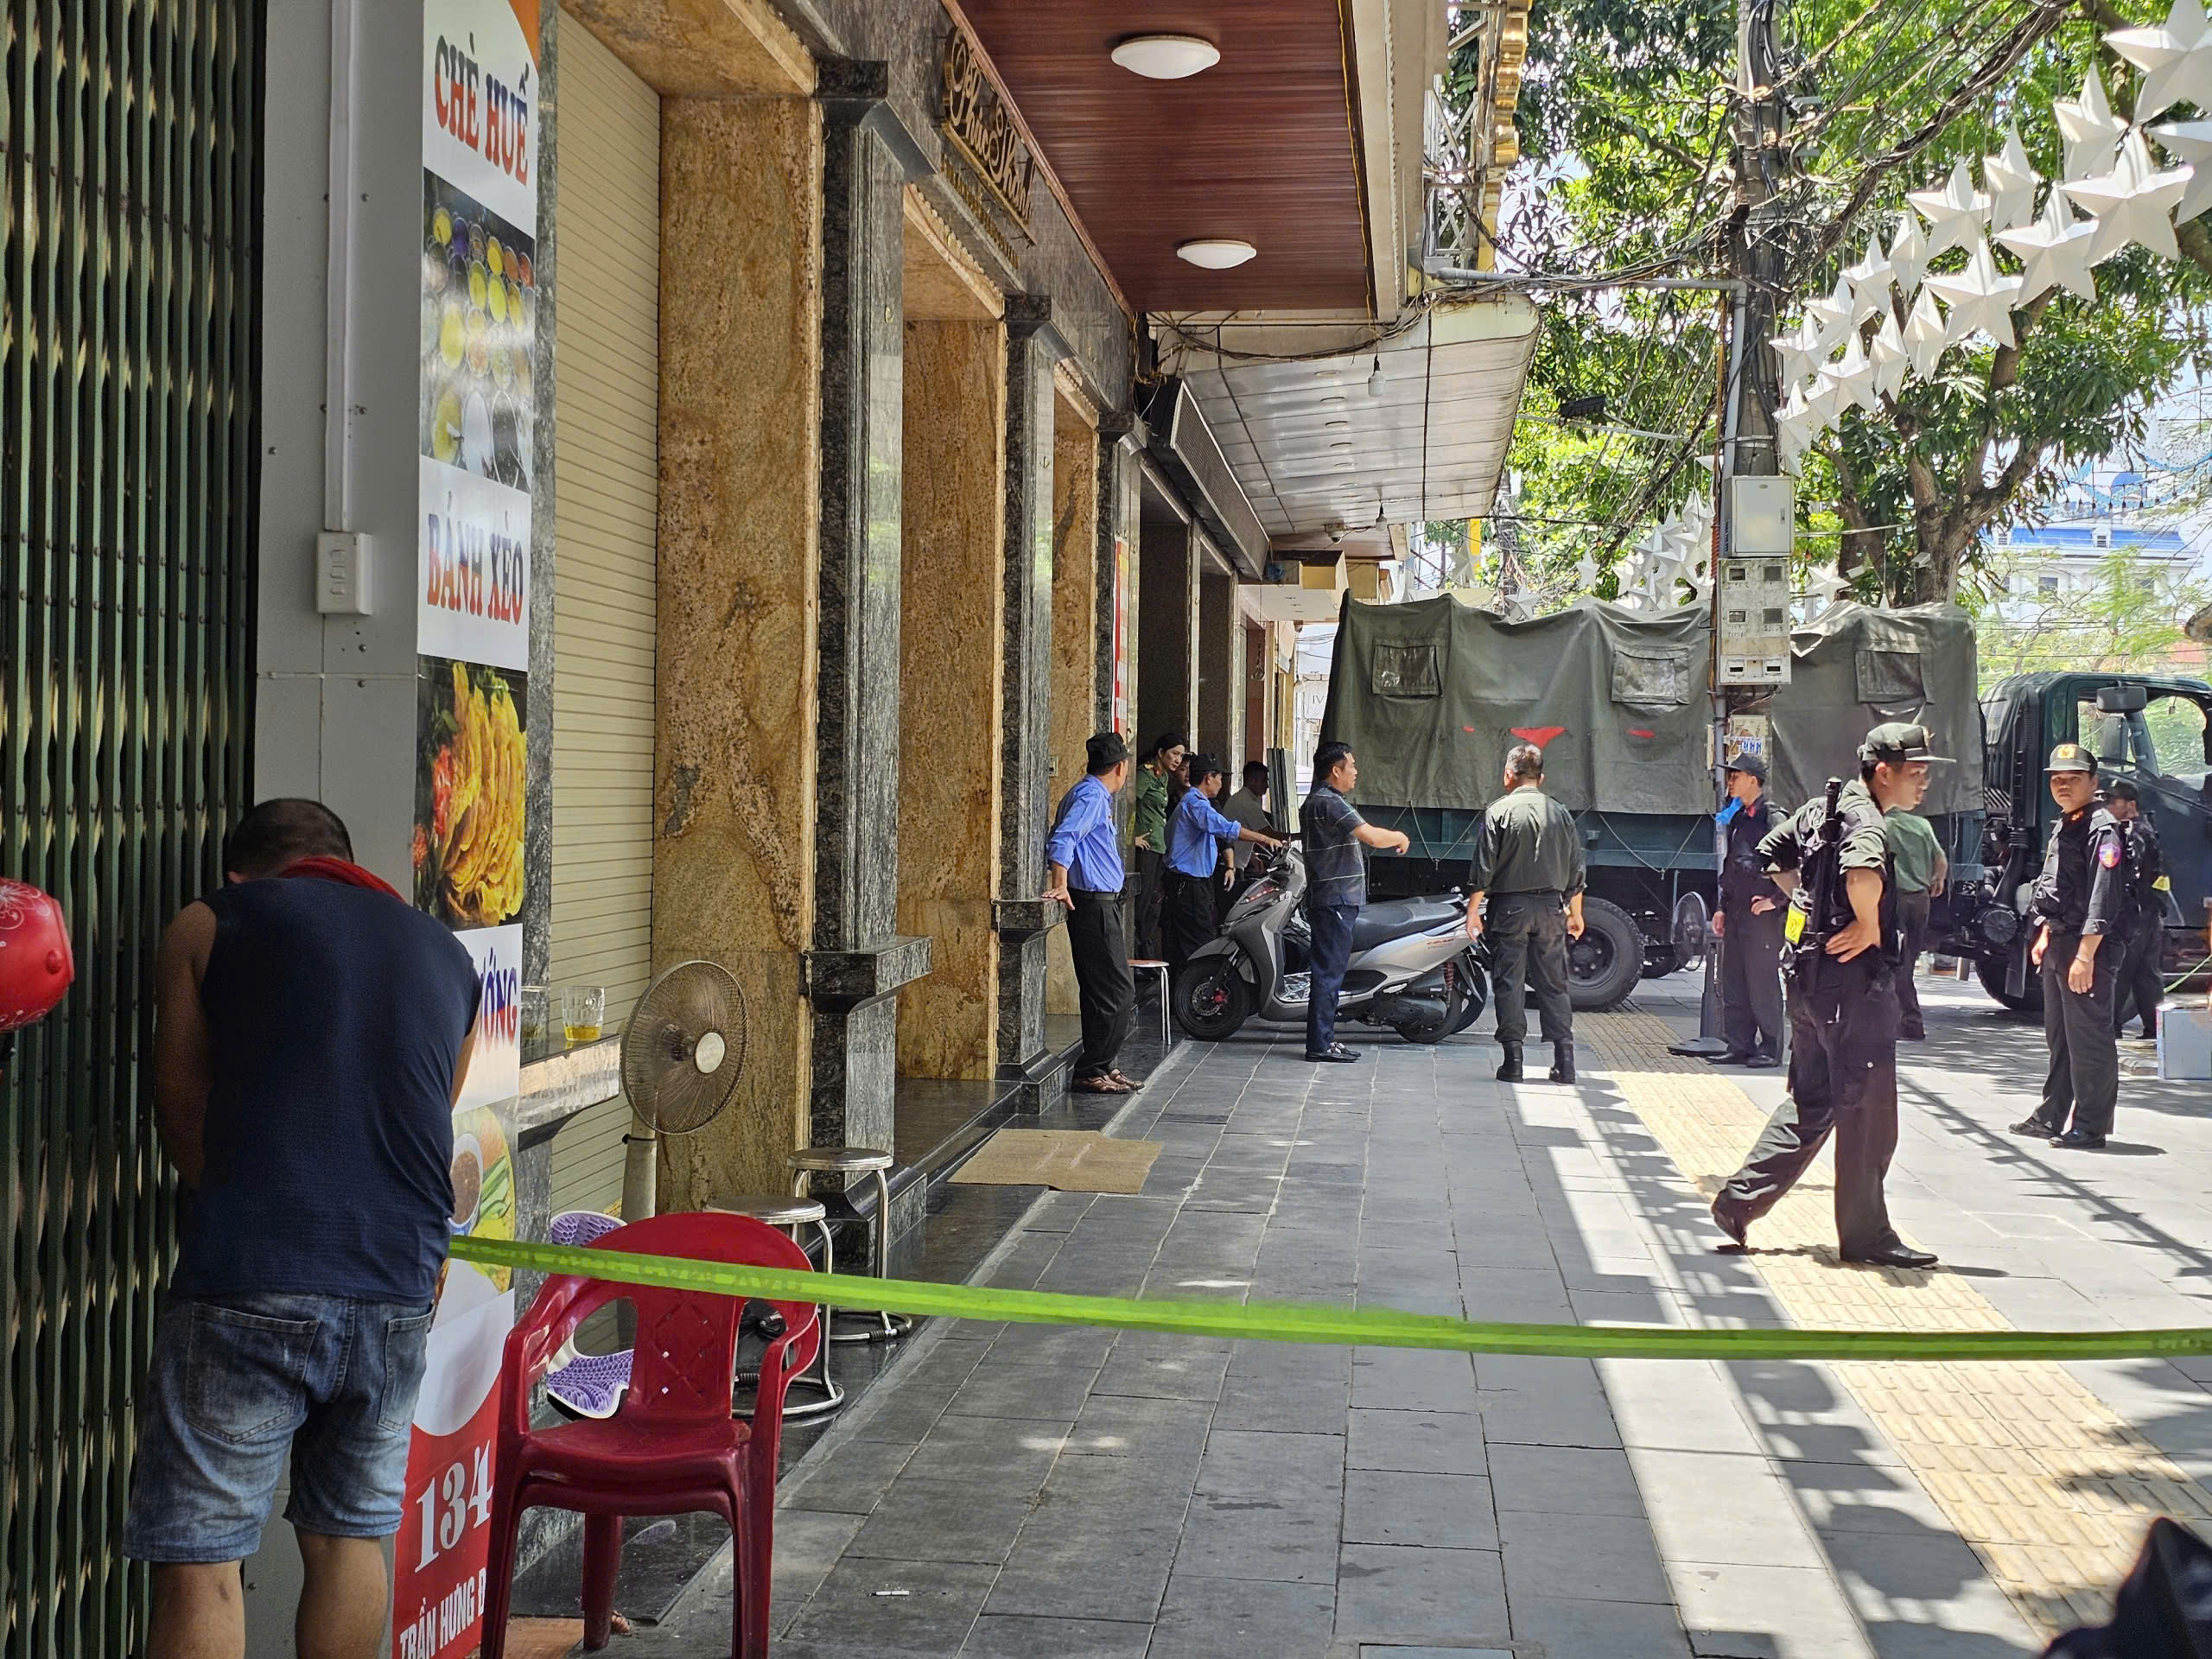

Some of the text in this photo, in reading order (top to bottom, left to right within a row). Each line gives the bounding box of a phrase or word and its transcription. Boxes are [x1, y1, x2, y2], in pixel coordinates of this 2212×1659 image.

[435, 31, 529, 187] CHÈ HUẾ
[427, 490, 524, 626] BÁNH XÈO
[415, 1440, 493, 1573] 134
[400, 1597, 436, 1659] TRẦN
[440, 1576, 474, 1649] HƯNG
